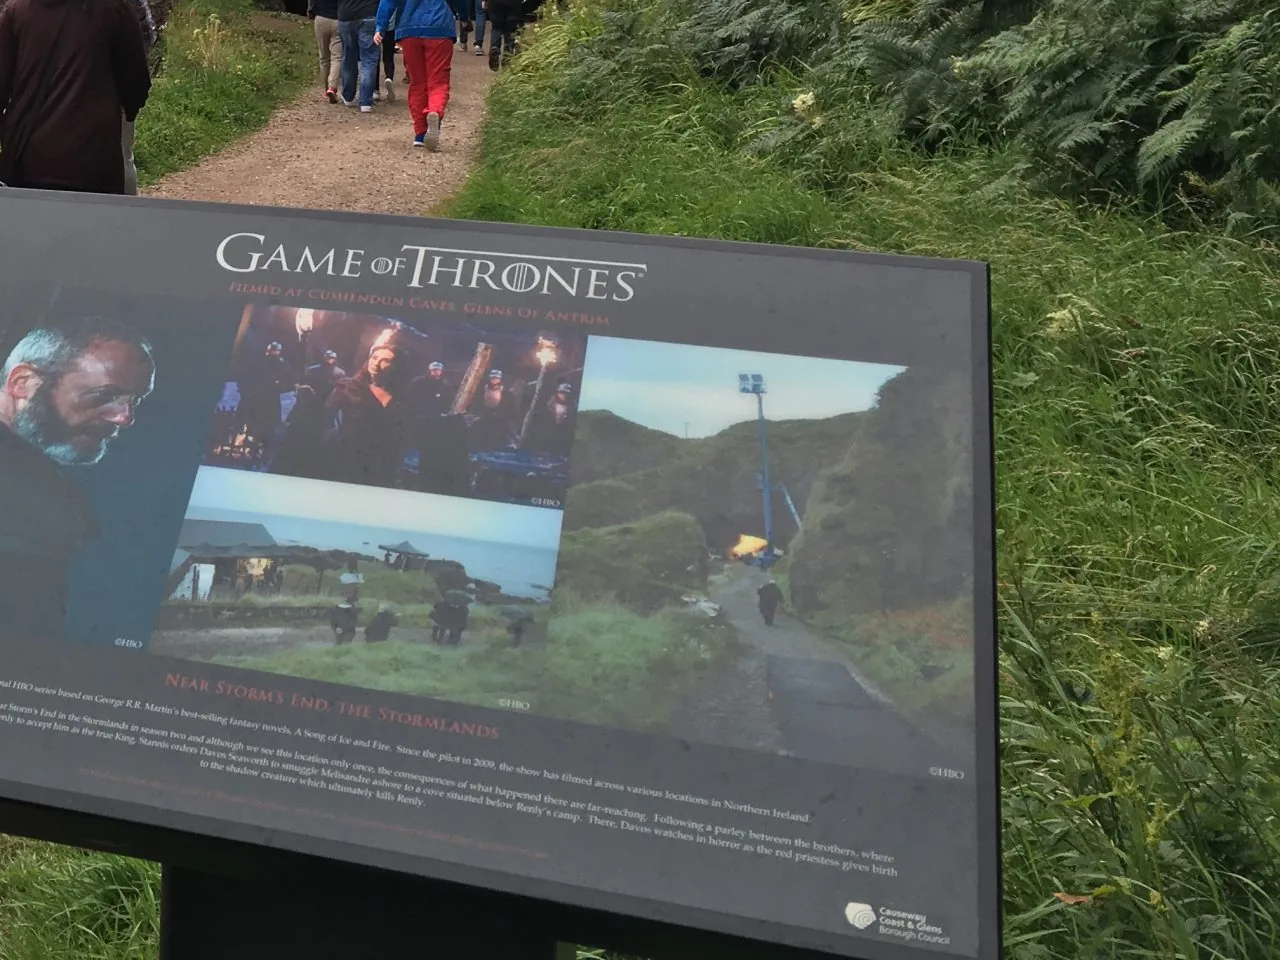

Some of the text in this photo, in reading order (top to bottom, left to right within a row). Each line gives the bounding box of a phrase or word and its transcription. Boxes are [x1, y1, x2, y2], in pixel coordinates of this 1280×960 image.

[216, 232, 365, 277] GAME
[371, 257, 406, 276] OF
[229, 281, 281, 297] FILMED
[284, 287, 302, 298] AT
[308, 288, 404, 307] CUSHENDUN
[463, 302, 513, 317] GLENS
[544, 310, 611, 326] ANTRIM
[165, 672, 210, 692] NEAR
[216, 680, 284, 705] STORM'S
[338, 701, 373, 719] THE
[378, 706, 501, 739] STORMLANDS
[12, 681, 34, 691] HBO
[34, 686, 57, 695] series
[58, 688, 82, 699] based
[94, 695, 124, 708] George
[145, 703, 179, 715] Martin's
[181, 708, 228, 726] best-selling
[229, 717, 261, 731] fantasy
[294, 728, 302, 736] A
[304, 729, 326, 742] Song
[327, 734, 338, 743] of
[338, 735, 352, 744] Ice
[353, 739, 371, 748] and
[396, 745, 421, 756] Since
[422, 749, 437, 759] the
[438, 753, 460, 763] pilot
[462, 756, 472, 765] in
[499, 762, 514, 772] the
[515, 765, 541, 776] show
[543, 769, 560, 780] has
[561, 773, 593, 786] filmed
[594, 780, 624, 791] across
[627, 786, 663, 797] various
[665, 790, 709, 805] locations
[711, 798, 721, 808] in
[724, 800, 770, 816] Northern
[8, 703, 38, 715] Storm's
[40, 708, 57, 718] End
[57, 712, 67, 720] in
[68, 713, 81, 722] the
[82, 715, 129, 730] Stormlands
[130, 724, 139, 732] in
[140, 727, 168, 737] season
[170, 731, 187, 740] two
[187, 735, 205, 743] and
[205, 737, 244, 751] although
[246, 745, 259, 753] we
[260, 747, 275, 755] see
[276, 748, 293, 758] this
[294, 751, 329, 764] location
[330, 759, 352, 771] only
[377, 766, 393, 776] the
[394, 771, 456, 786] consequences
[457, 780, 468, 789] of
[469, 783, 493, 793] what
[494, 786, 542, 802] happened
[543, 795, 568, 806] there
[570, 801, 586, 809] are
[654, 813, 704, 832] Following
[714, 826, 746, 840] parley
[749, 830, 792, 845] between
[794, 838, 811, 848] the
[861, 851, 894, 863] where
[16, 716, 25, 724] to
[26, 719, 52, 730] accept
[53, 722, 70, 732] him
[81, 727, 95, 736] the
[96, 730, 114, 739] true
[139, 736, 169, 749] Stannis
[170, 744, 198, 754] orders
[199, 747, 227, 759] Davos
[270, 760, 280, 768] to
[281, 763, 319, 776] smuggle
[321, 768, 371, 784] Melisandre
[372, 778, 403, 790] ashore
[404, 784, 414, 792] to
[422, 788, 445, 797] cove
[446, 791, 484, 804] situated
[485, 796, 514, 809] below
[516, 802, 551, 816] Renly's
[620, 820, 652, 833] Davos
[654, 828, 694, 841] watches
[696, 834, 707, 843] in
[708, 836, 741, 849] horror
[742, 844, 755, 852] as
[756, 844, 773, 855] the
[775, 849, 793, 858] red
[795, 853, 840, 866] priestess
[842, 861, 870, 872] gives
[872, 864, 898, 877] birth
[200, 760, 209, 768] to
[210, 761, 225, 771] the
[225, 764, 260, 776] shadow
[261, 772, 298, 783] creature
[299, 777, 327, 788] which
[328, 783, 373, 799] ultimately
[376, 790, 395, 801] kills
[879, 907, 927, 924] Causeway
[879, 916, 943, 934] Coast & Glens
[879, 925, 951, 945] Borough Council
